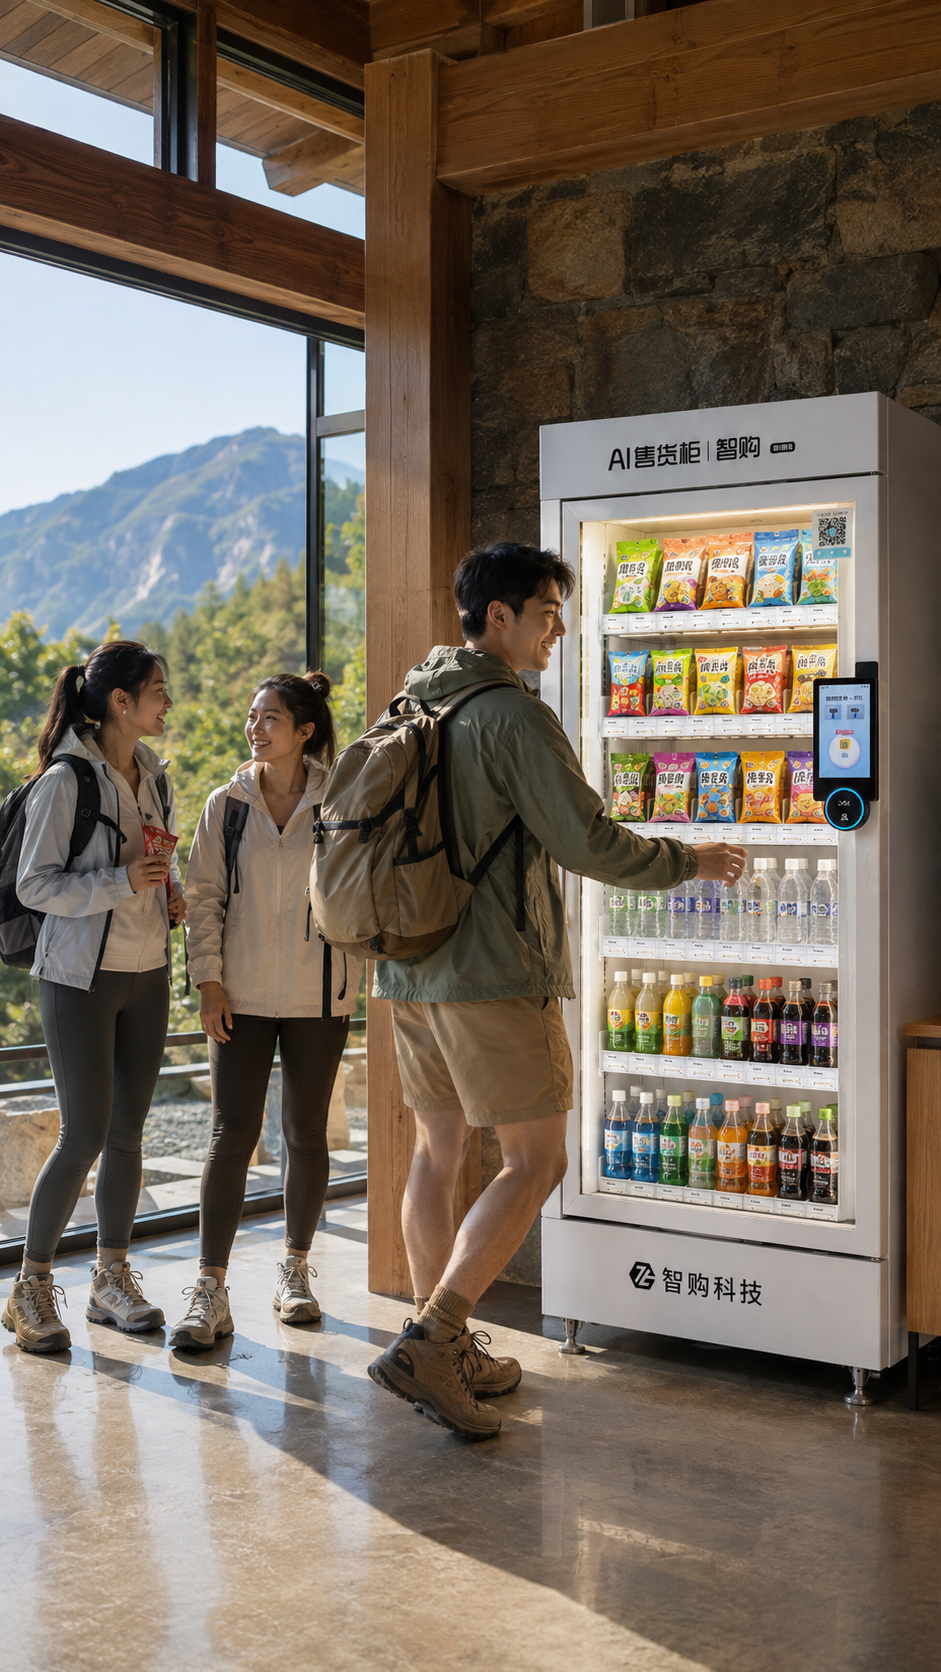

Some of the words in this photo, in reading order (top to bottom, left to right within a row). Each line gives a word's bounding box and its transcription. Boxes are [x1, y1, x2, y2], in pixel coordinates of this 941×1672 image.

[608, 440, 701, 471] AI售货柜
[717, 436, 760, 461] 智购
[662, 1266, 762, 1307] 智购科技
